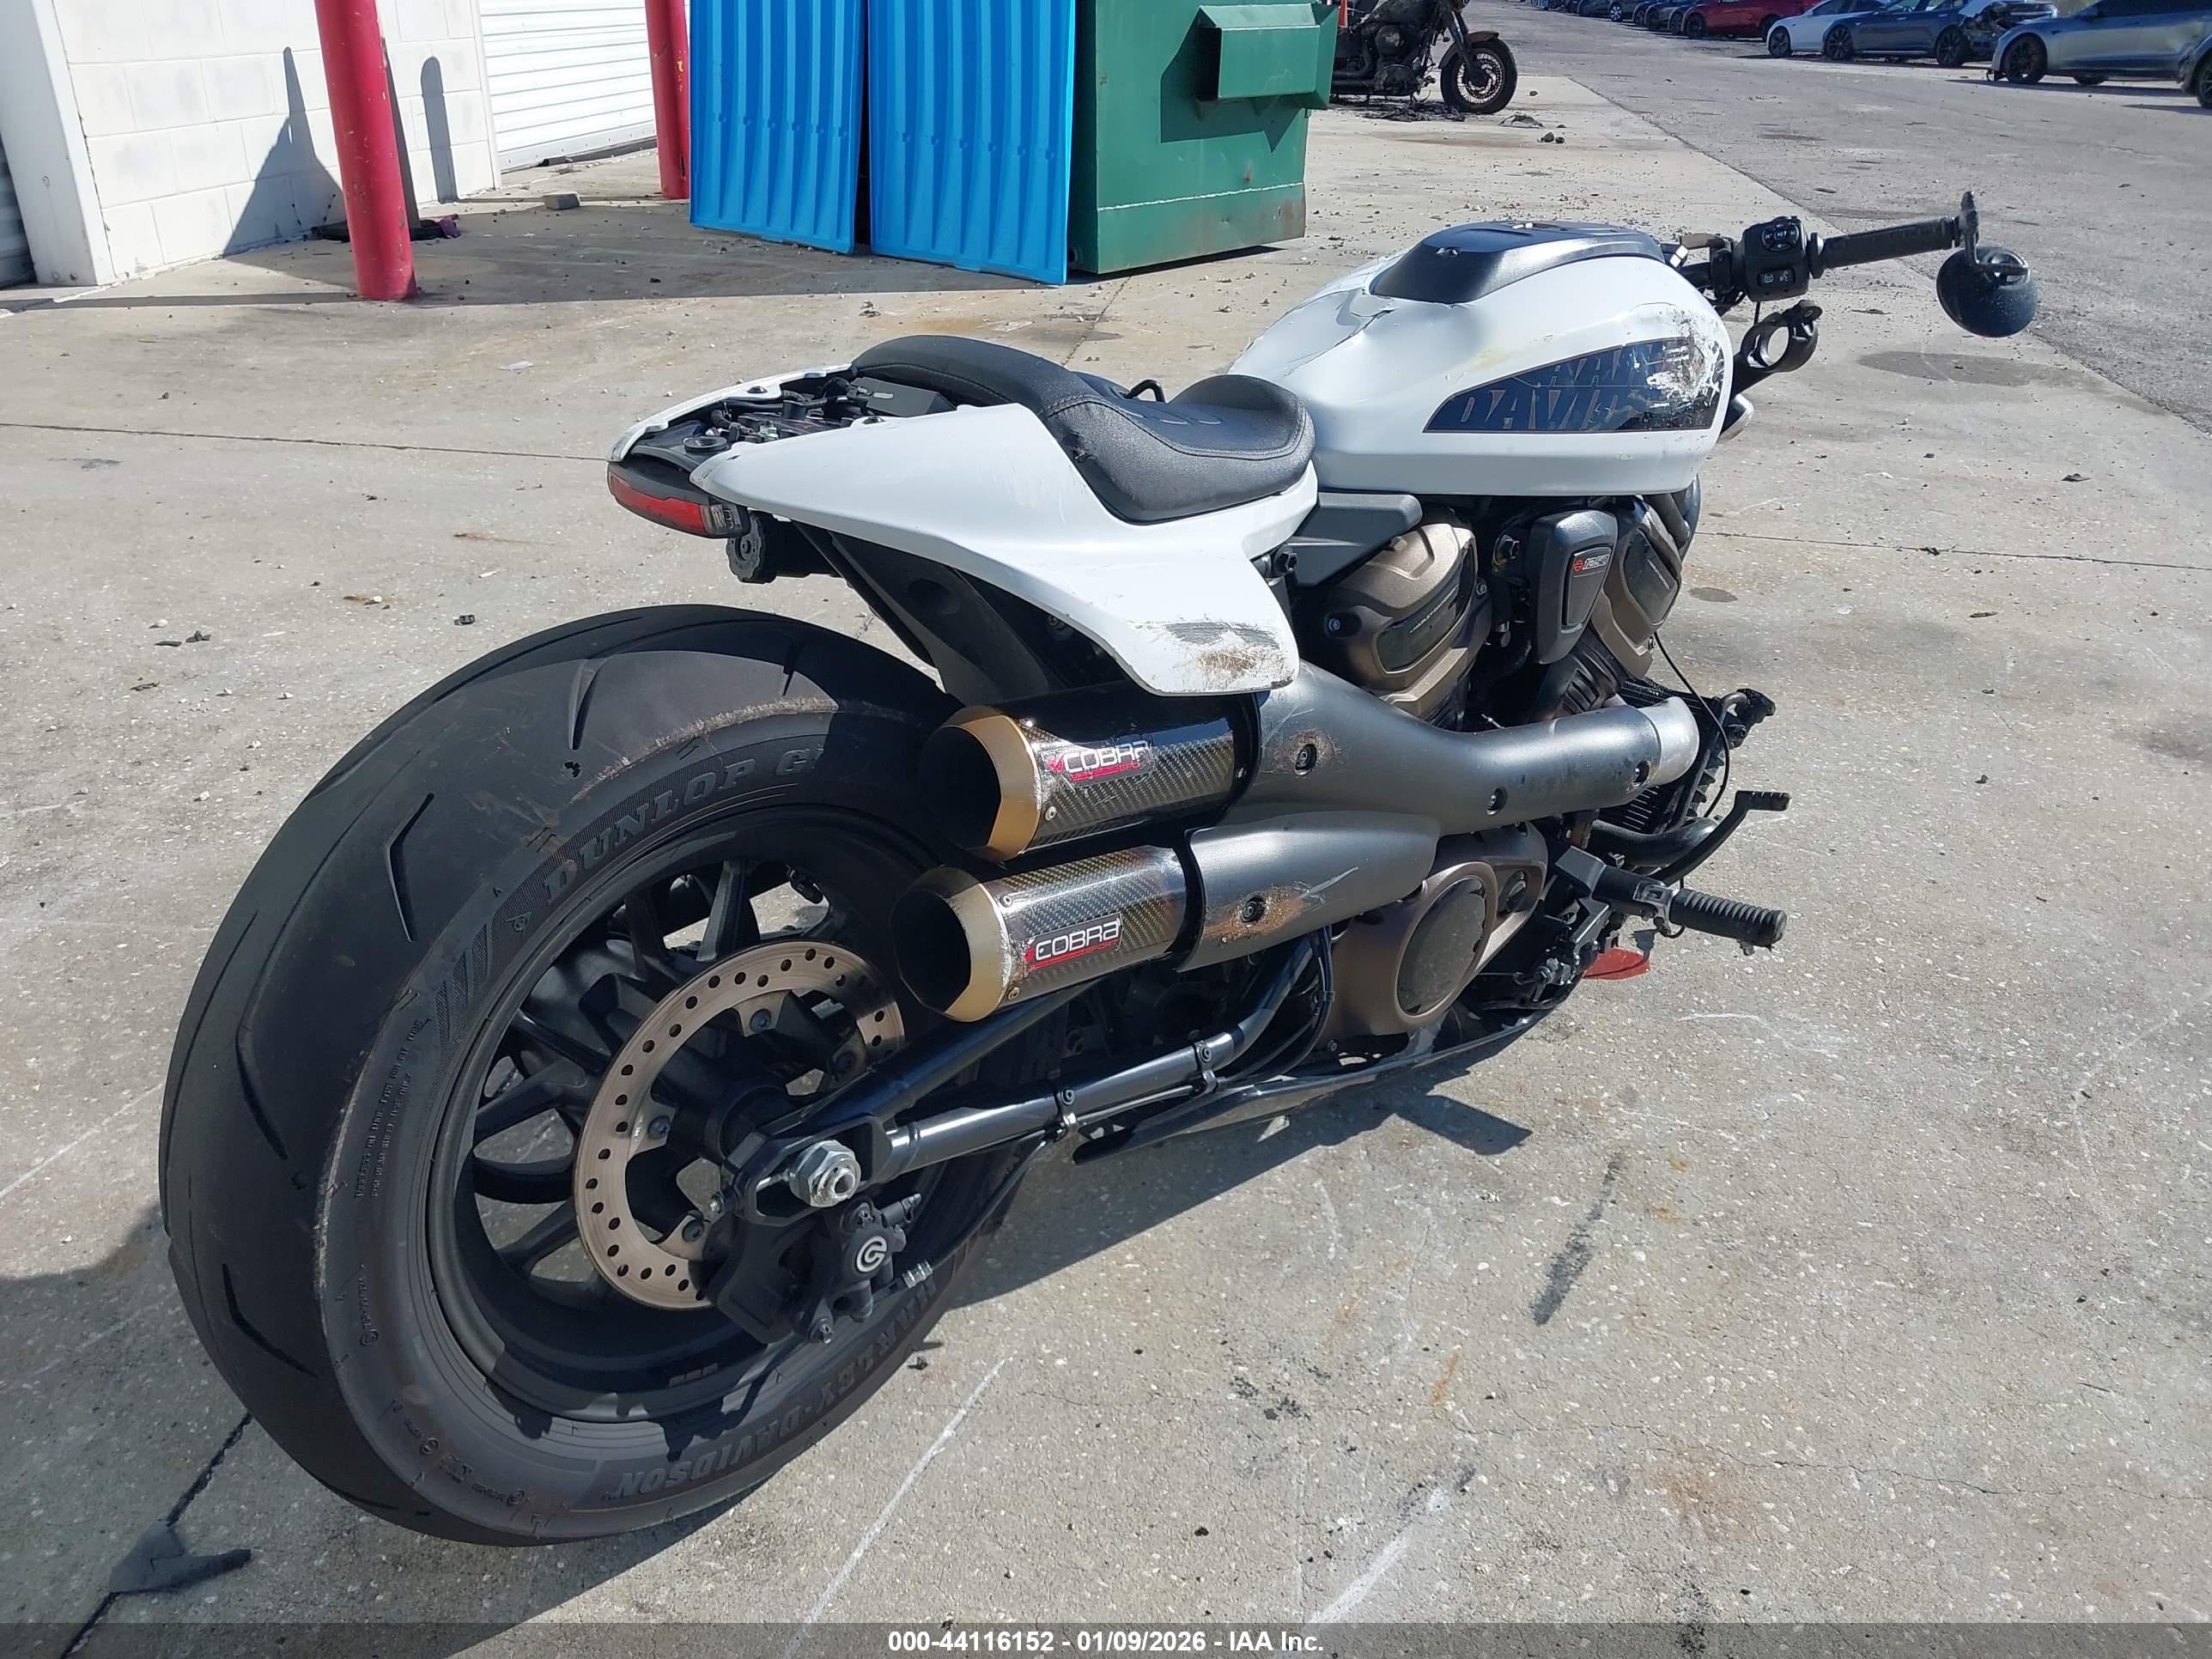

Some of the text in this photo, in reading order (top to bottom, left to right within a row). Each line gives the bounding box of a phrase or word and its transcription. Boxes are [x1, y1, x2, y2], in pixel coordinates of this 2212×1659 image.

[1064, 740, 1152, 773] COBRA
[542, 758, 757, 903] DUNLOP
[1036, 921, 1120, 961] COBRA
